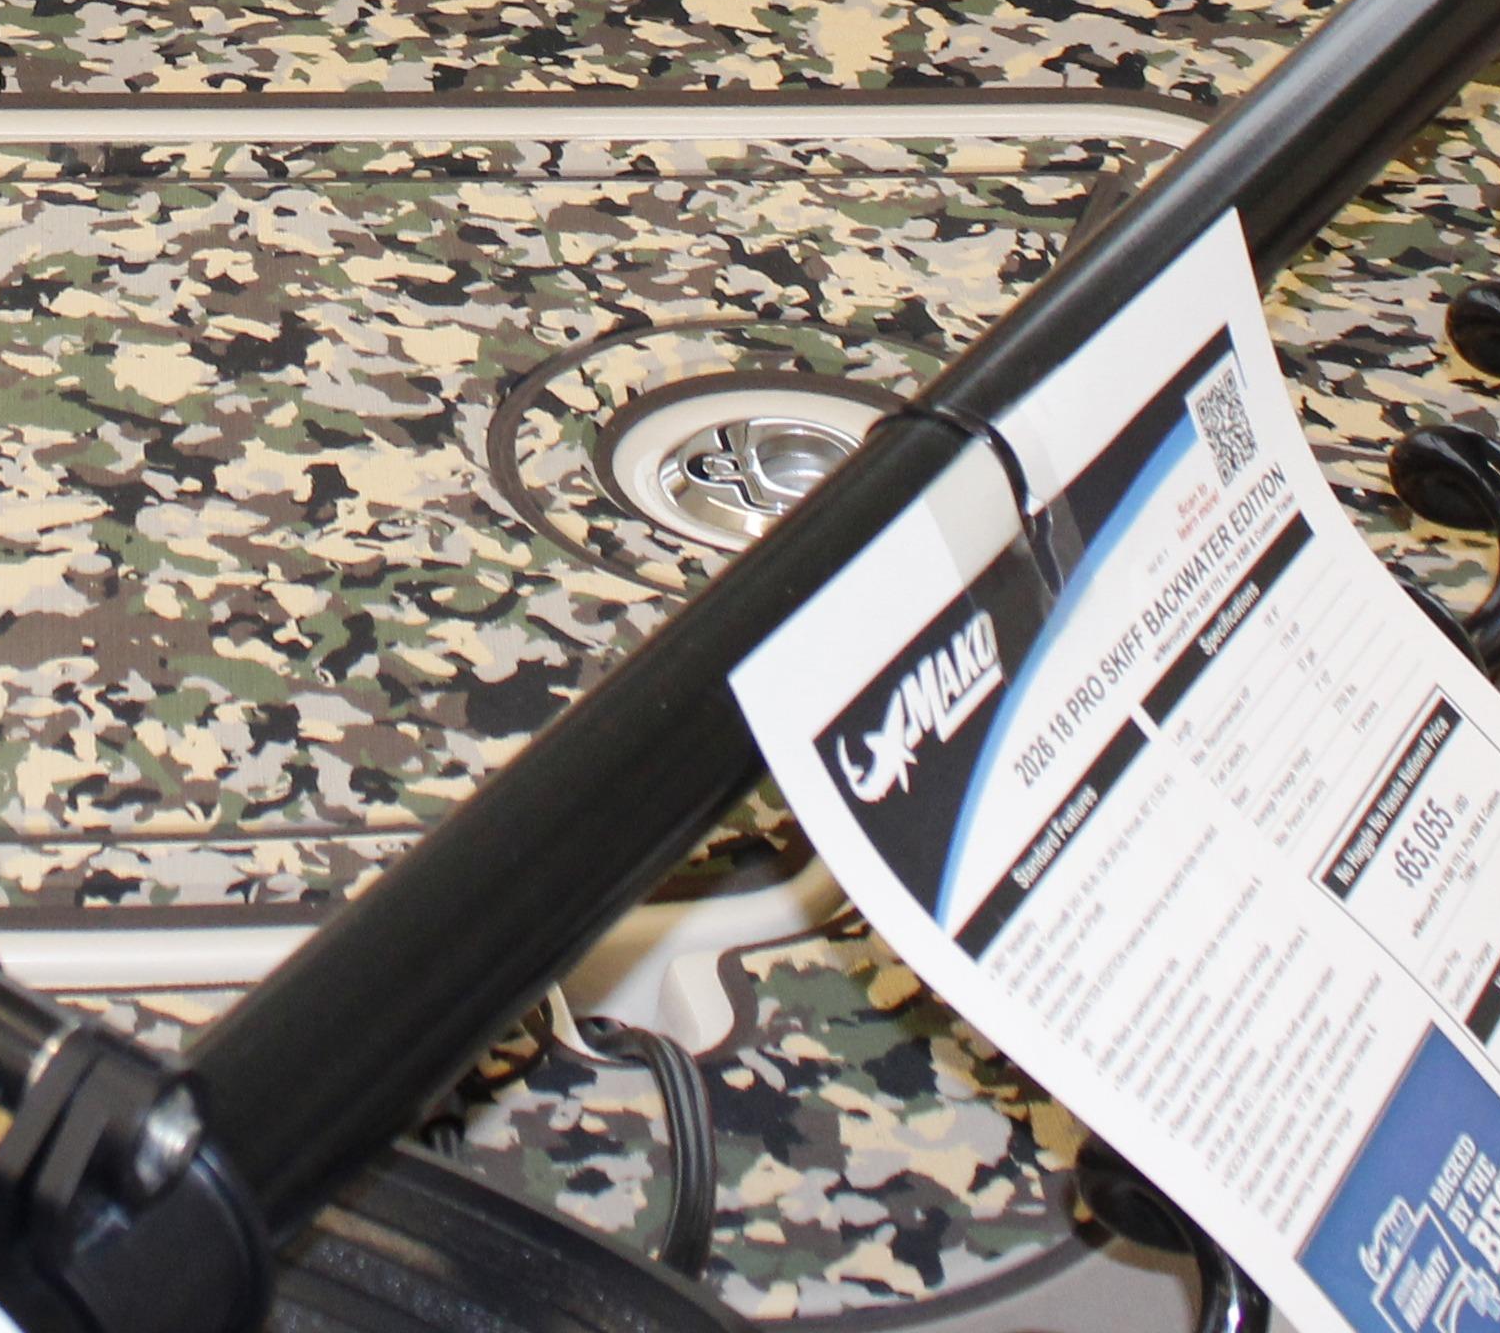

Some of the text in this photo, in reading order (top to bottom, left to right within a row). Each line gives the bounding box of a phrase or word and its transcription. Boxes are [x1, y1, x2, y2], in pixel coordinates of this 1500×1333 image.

[1012, 730, 1057, 789] 2026
[1048, 709, 1074, 748] 18
[1065, 670, 1107, 727] PRO
[1099, 622, 1147, 687] SKIFF
[1140, 519, 1234, 638] BACKWATER
[1227, 460, 1286, 537] EDITION
[1196, 577, 1262, 659] Specifications
[897, 611, 1002, 749] MAKO
[1009, 829, 1064, 891] Standard
[1049, 781, 1102, 841] Features
[1331, 711, 1451, 887] No Haggle No Hassle National Price
[1392, 794, 1455, 889] $65,055
[1428, 1132, 1478, 1211] BACKED
[1446, 1151, 1497, 1233] BY THE
